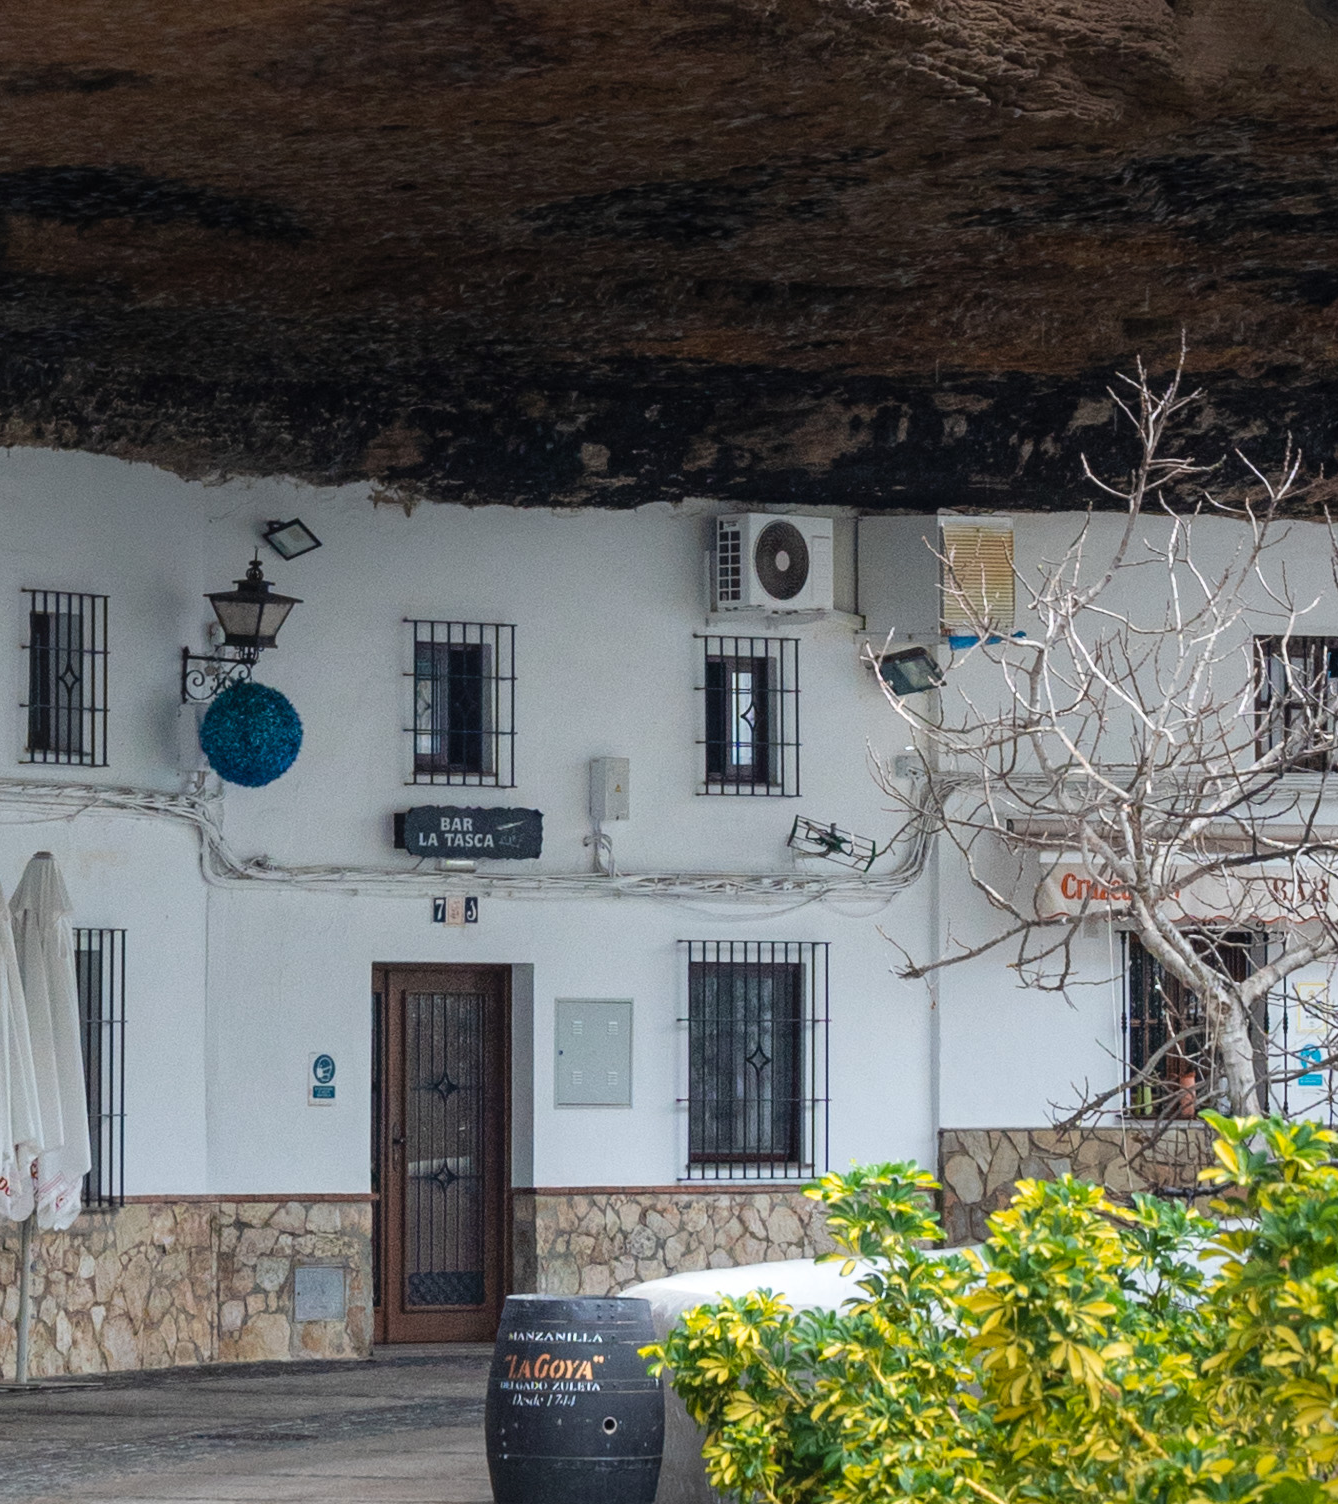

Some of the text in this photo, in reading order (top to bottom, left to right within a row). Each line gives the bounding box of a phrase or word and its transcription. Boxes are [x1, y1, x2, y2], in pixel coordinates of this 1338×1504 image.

[440, 817, 473, 832] BAR
[418, 832, 495, 848] LA TASCA
[434, 898, 445, 920] 7
[508, 1331, 603, 1343] MANZANILLA
